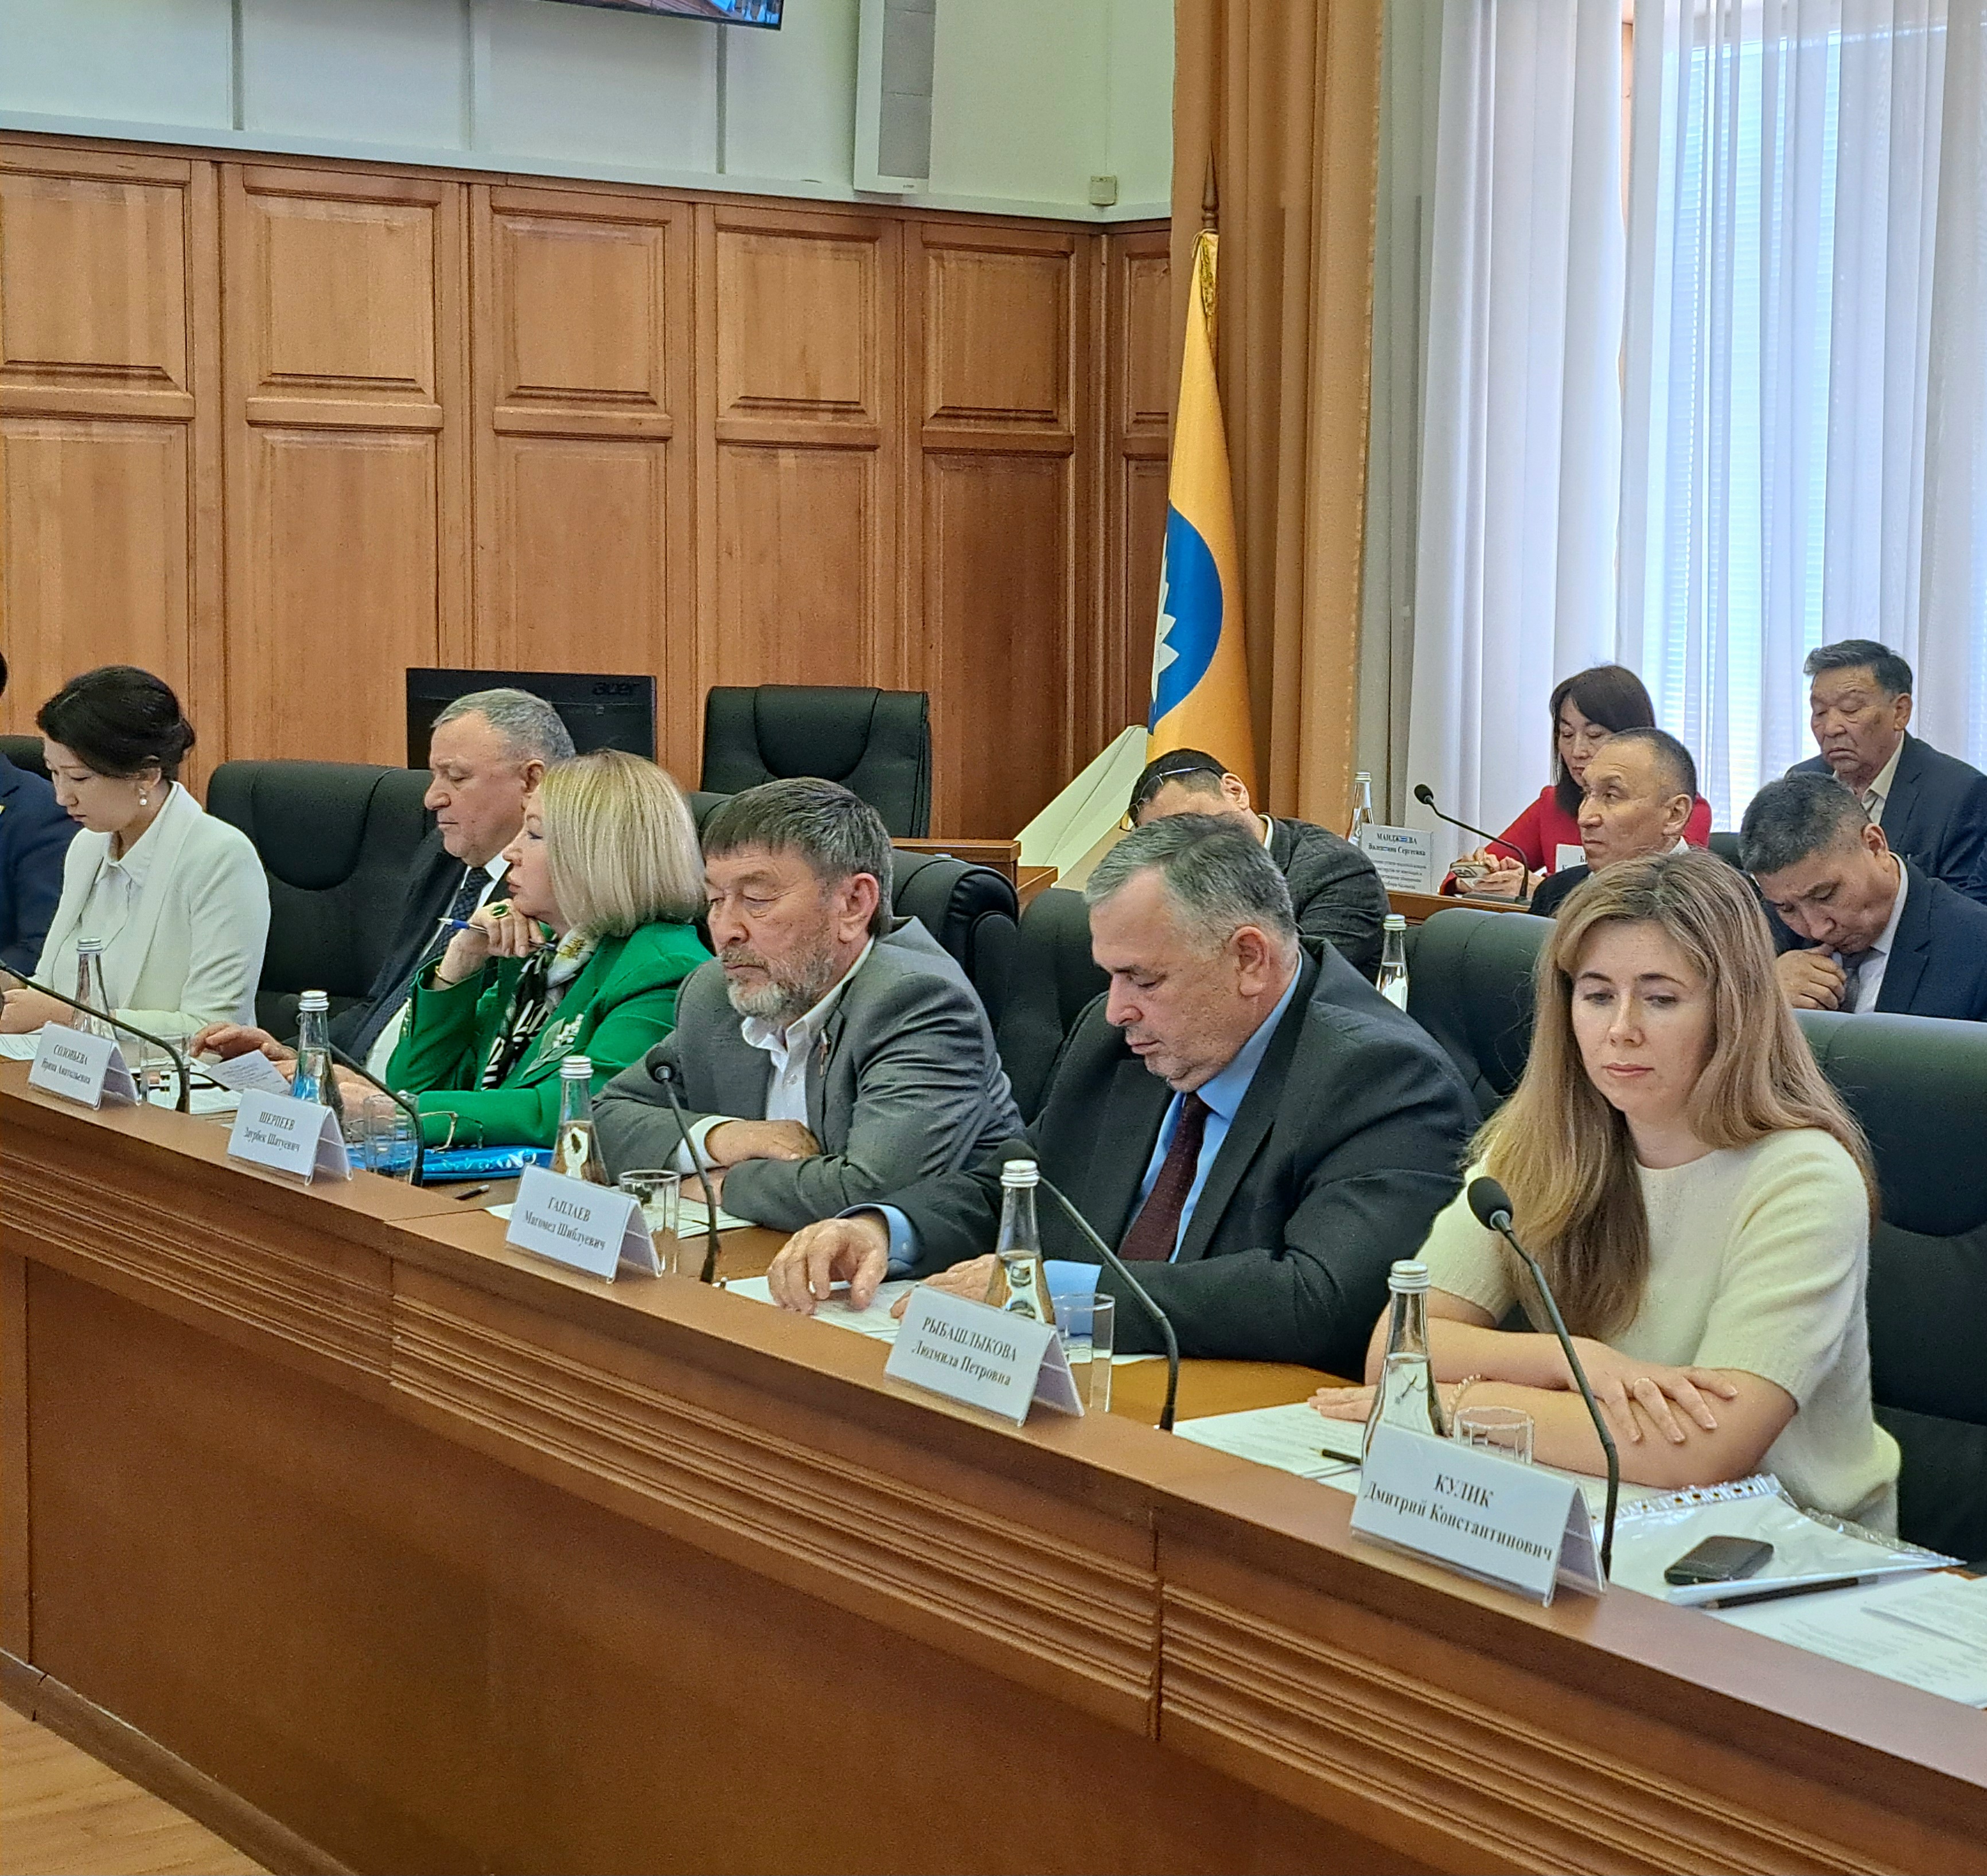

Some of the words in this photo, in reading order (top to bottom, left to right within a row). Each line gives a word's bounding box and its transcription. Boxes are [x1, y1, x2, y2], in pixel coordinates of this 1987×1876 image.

[1368, 843, 1397, 853] Валеина
[259, 1111, 295, 1131] ШЕРПЕЕВ
[524, 1210, 556, 1232] Магомед
[921, 1317, 1018, 1363] РЫБАШЛЫКОВА
[911, 1340, 959, 1368] Людмила
[960, 1355, 1012, 1387] Петровна
[1433, 1473, 1495, 1509] КУЛИК
[1363, 1480, 1427, 1517] Дмитрий
[1429, 1502, 1553, 1561] Константинович
